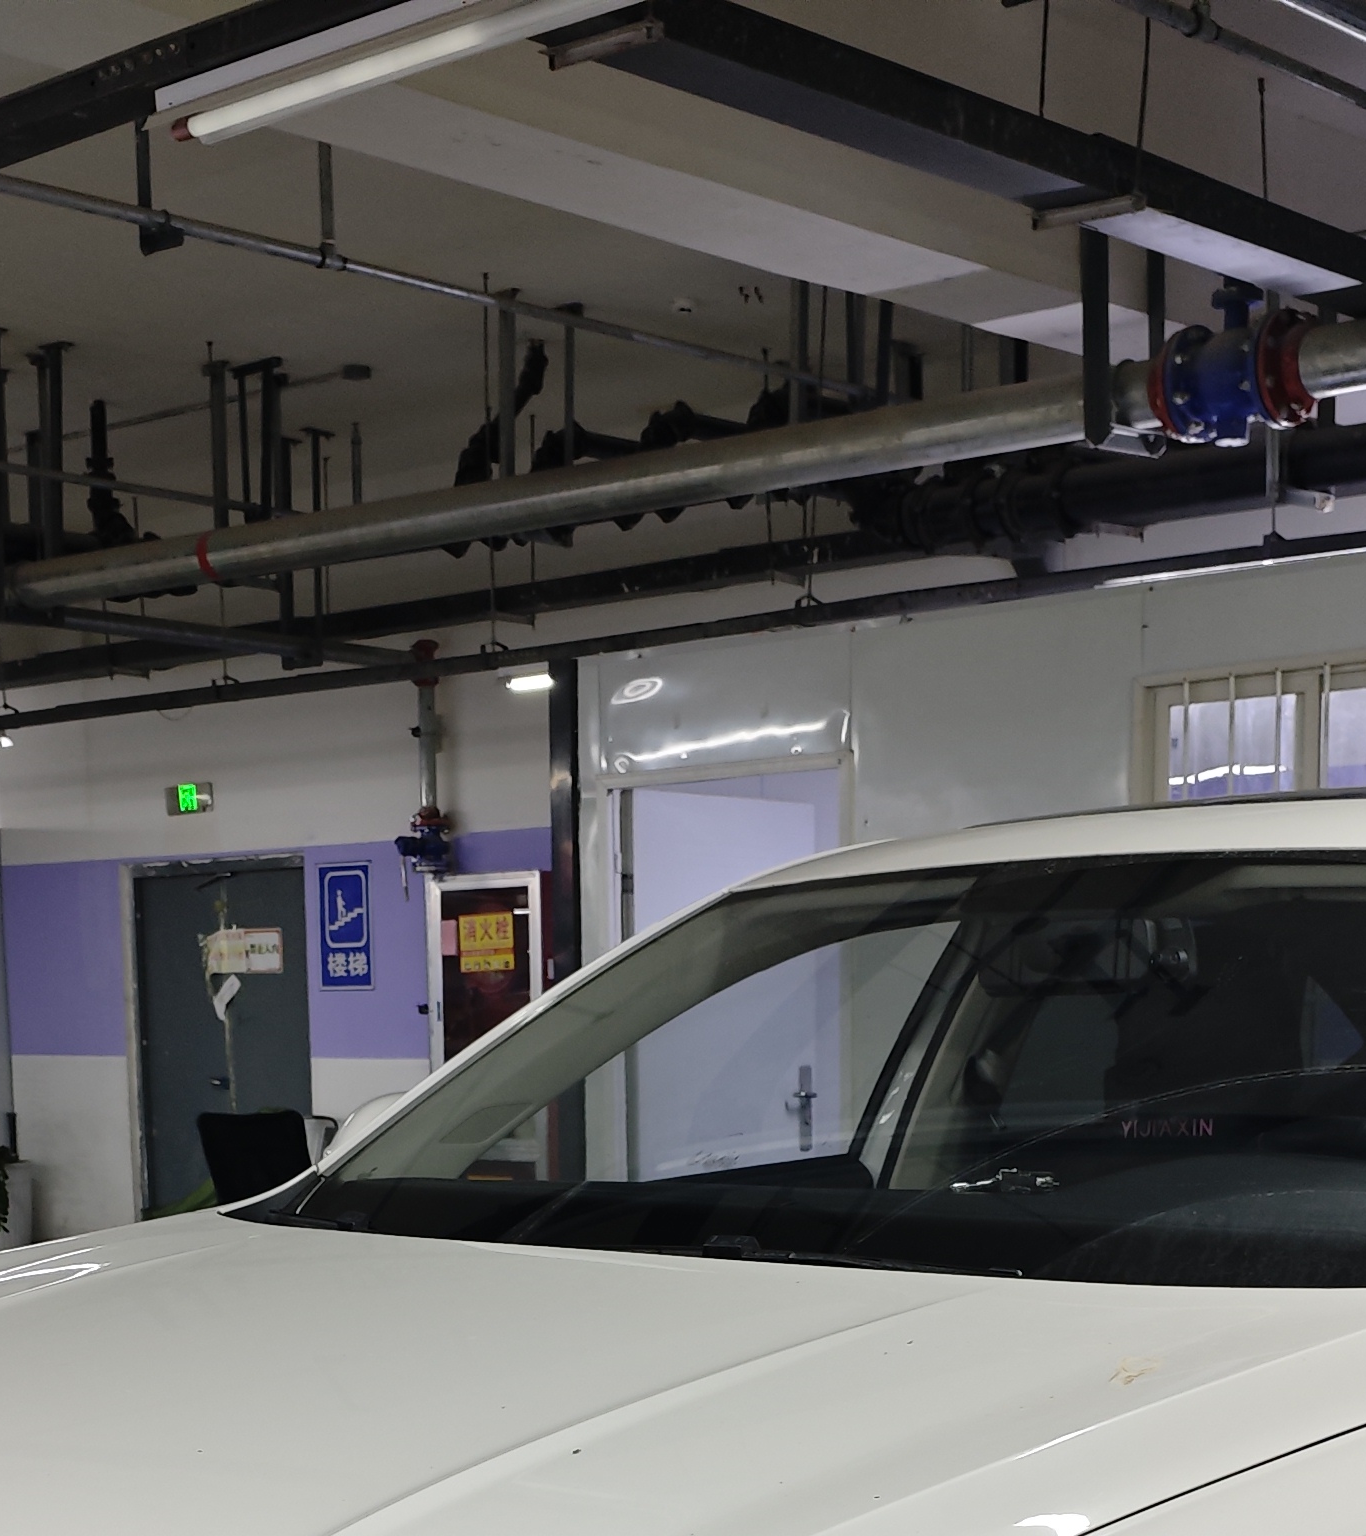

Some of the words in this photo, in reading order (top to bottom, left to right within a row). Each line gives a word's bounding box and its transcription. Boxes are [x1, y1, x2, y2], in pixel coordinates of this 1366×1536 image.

[462, 917, 510, 943] 消火栓
[327, 952, 368, 978] 楼梯
